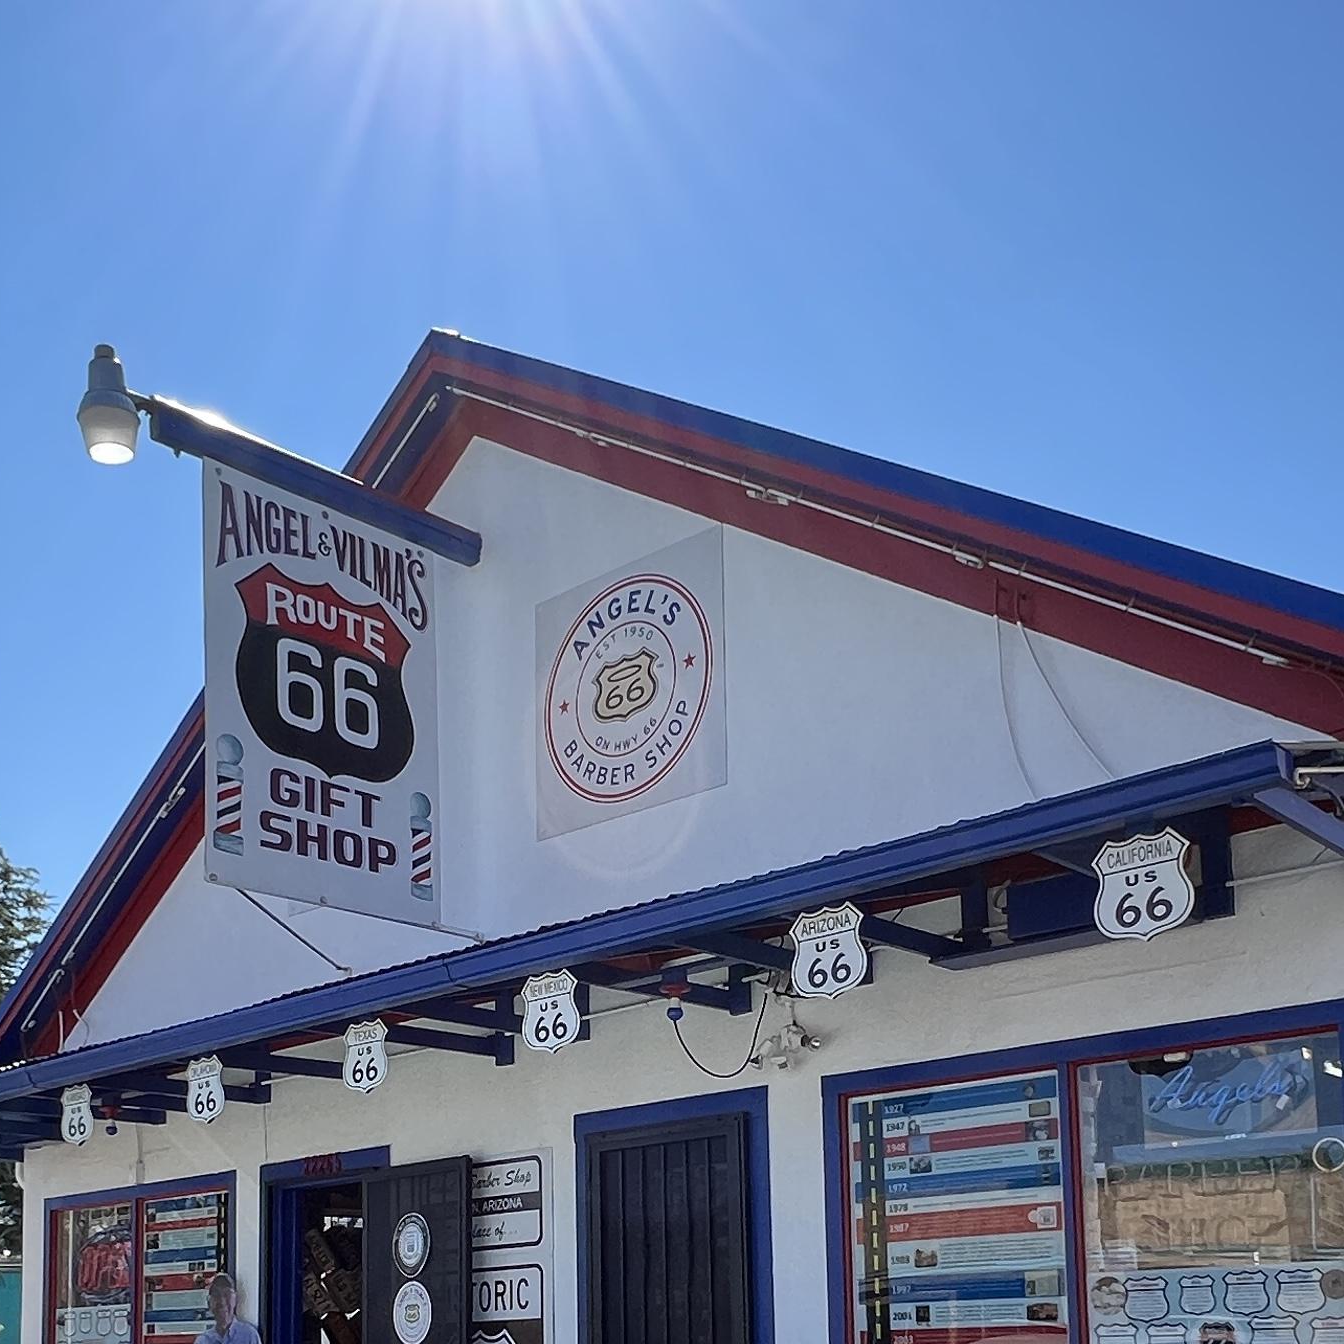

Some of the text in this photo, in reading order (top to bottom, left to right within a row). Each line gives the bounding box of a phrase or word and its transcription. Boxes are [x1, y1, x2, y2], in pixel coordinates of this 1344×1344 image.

[215, 480, 428, 633] ANGEL & VILMA'S
[266, 582, 387, 663] ROUTE
[573, 589, 681, 660] ANGEL'S
[596, 626, 654, 659] EST 1950
[276, 637, 381, 750] 66
[605, 677, 645, 709] 66
[563, 700, 688, 785] BARBER SHOP
[595, 717, 657, 751] ON HWY 66
[269, 767, 382, 829] GIFT
[259, 809, 398, 874] SHOP
[1106, 837, 1173, 870] CALIFORNIA
[1125, 869, 1158, 887] US
[1115, 886, 1173, 928] 66
[800, 912, 853, 937] ARIZONA
[815, 939, 841, 953] US
[807, 952, 852, 988] 66
[539, 1000, 559, 1012] US
[353, 1027, 378, 1042] TEXAS
[534, 1012, 567, 1042] 66
[357, 1047, 372, 1056] US
[352, 1057, 379, 1083] 66
[194, 1091, 217, 1115] 66
[68, 1116, 87, 1137] 66
[482, 1197, 523, 1212] ARIZONA
